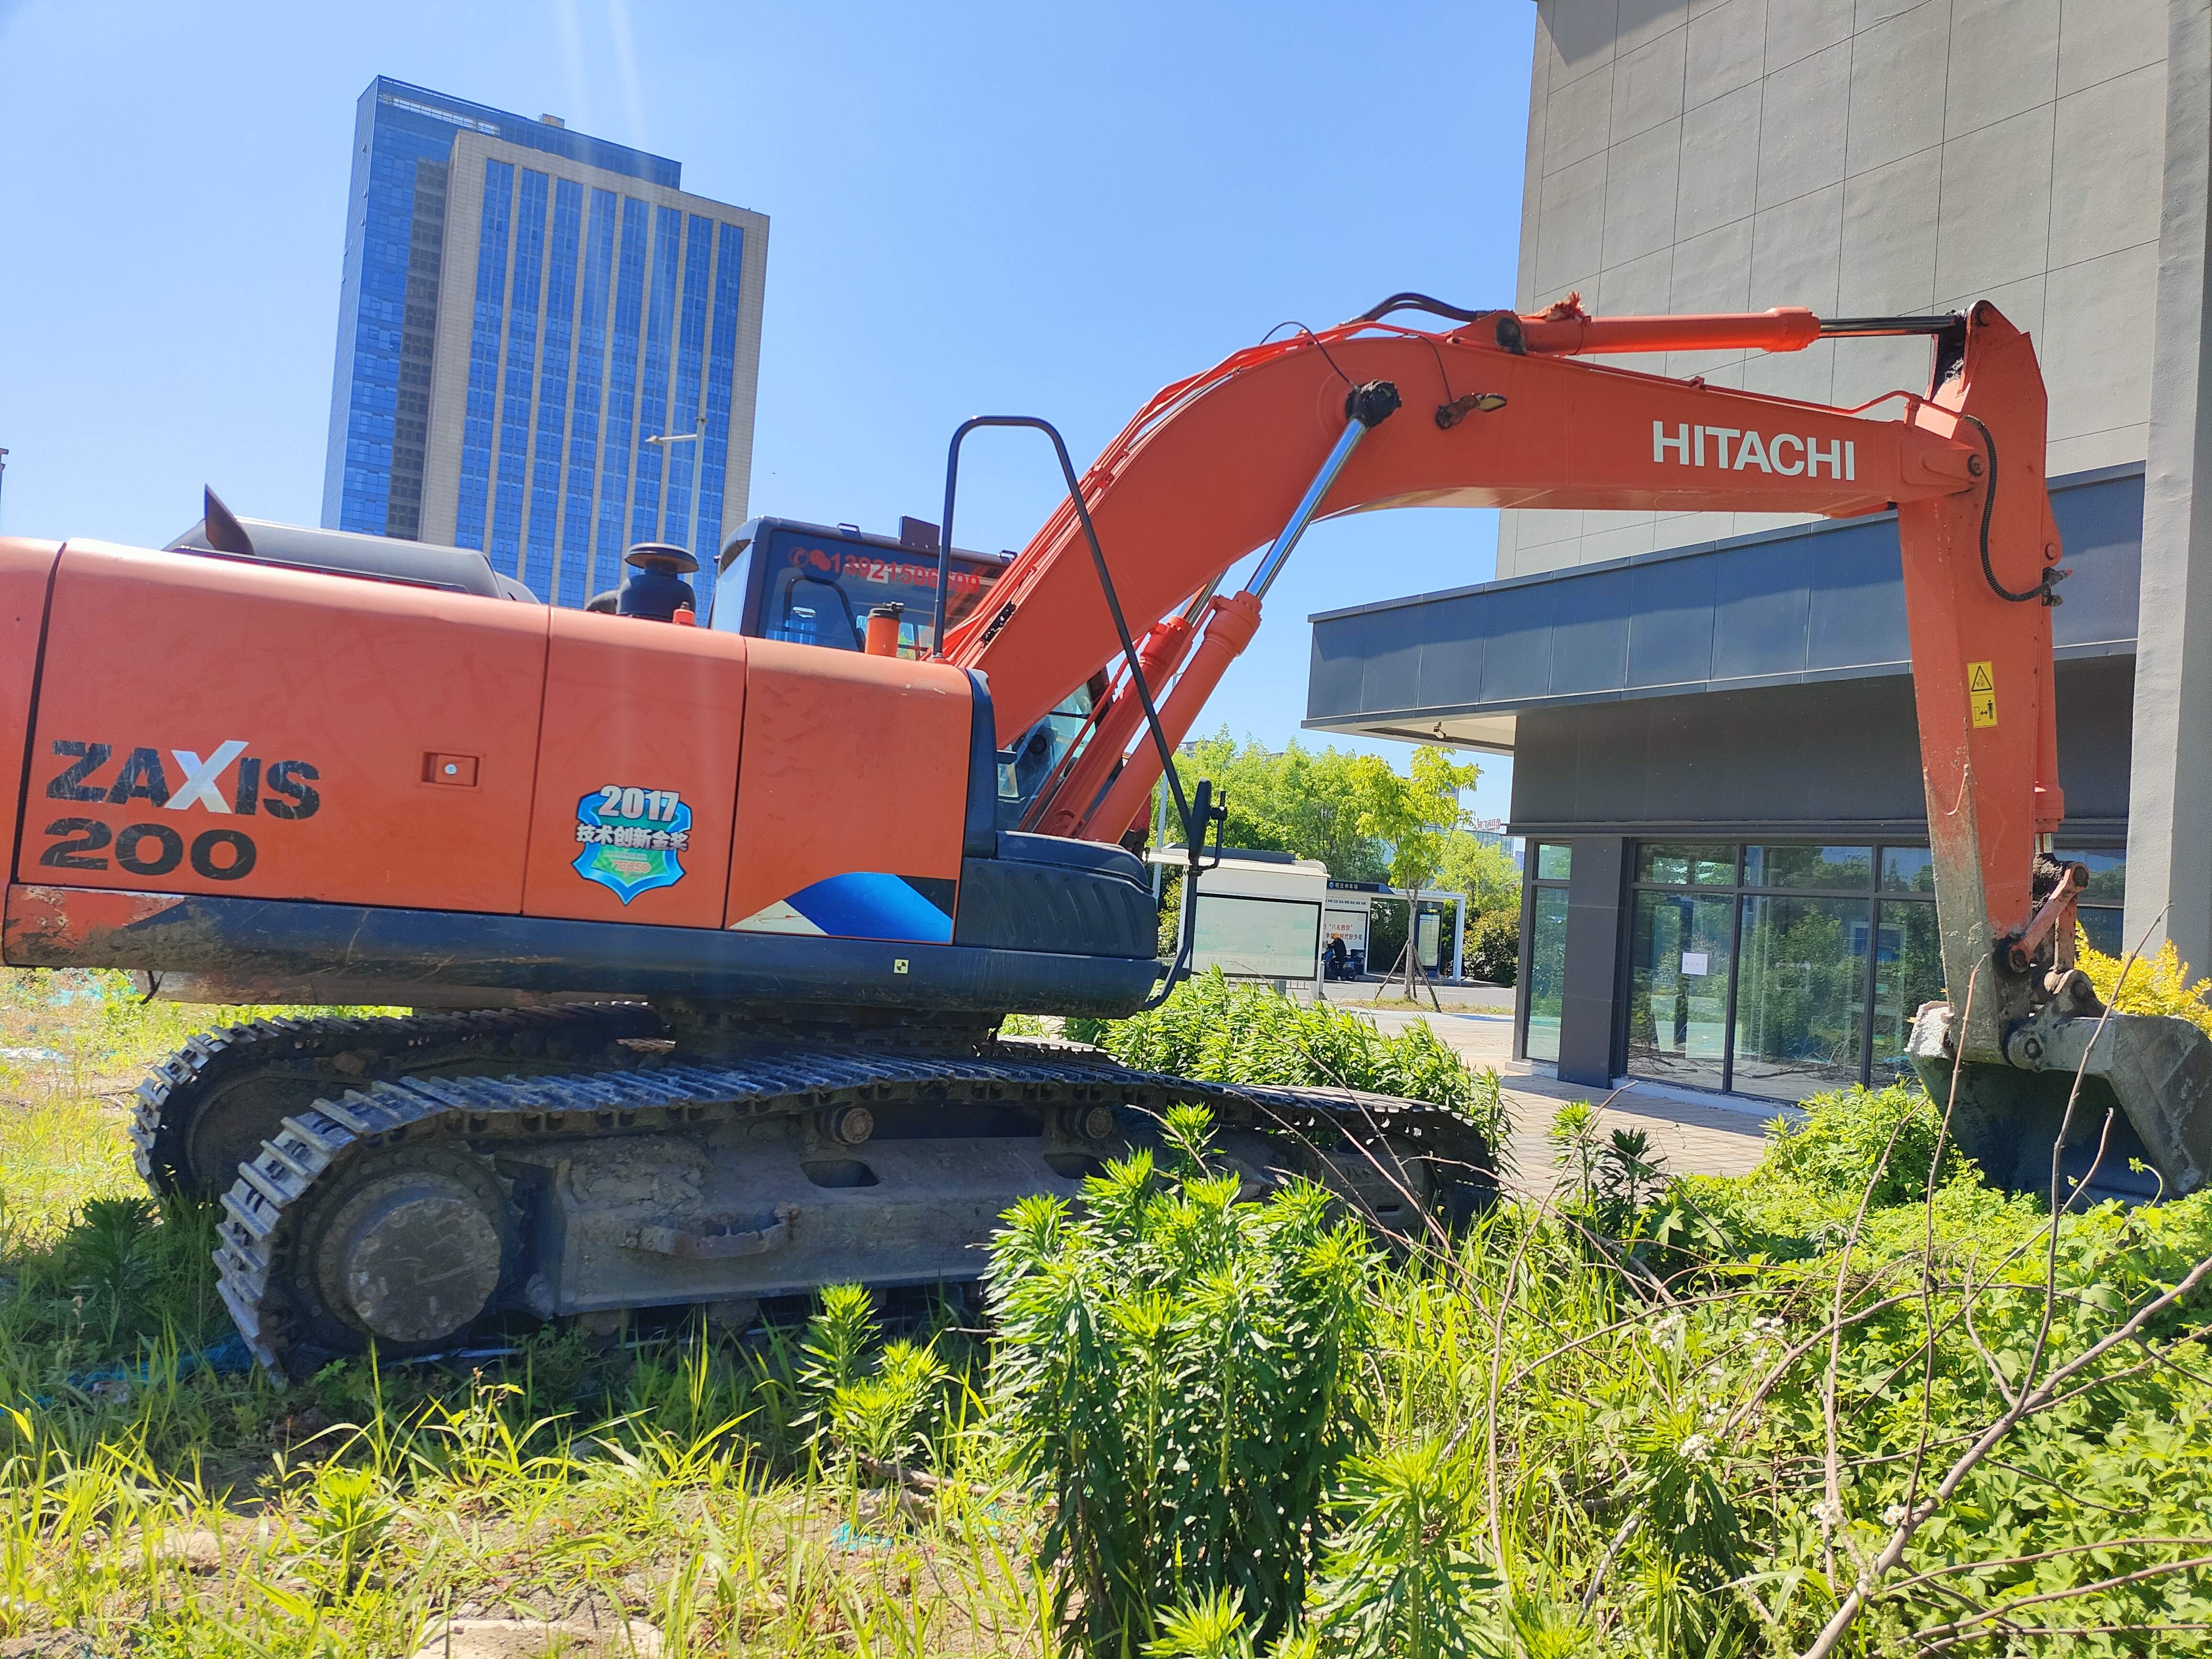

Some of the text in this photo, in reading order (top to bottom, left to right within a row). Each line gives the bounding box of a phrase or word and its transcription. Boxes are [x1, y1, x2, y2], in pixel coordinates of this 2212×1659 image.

[1653, 421, 1855, 481] HITACHI
[46, 740, 321, 820] ZAXIS
[598, 785, 679, 821] 2017
[40, 818, 257, 880] 200
[576, 824, 689, 851] 技术创新金奖
[1326, 932, 1362, 940] 争时代好少年
